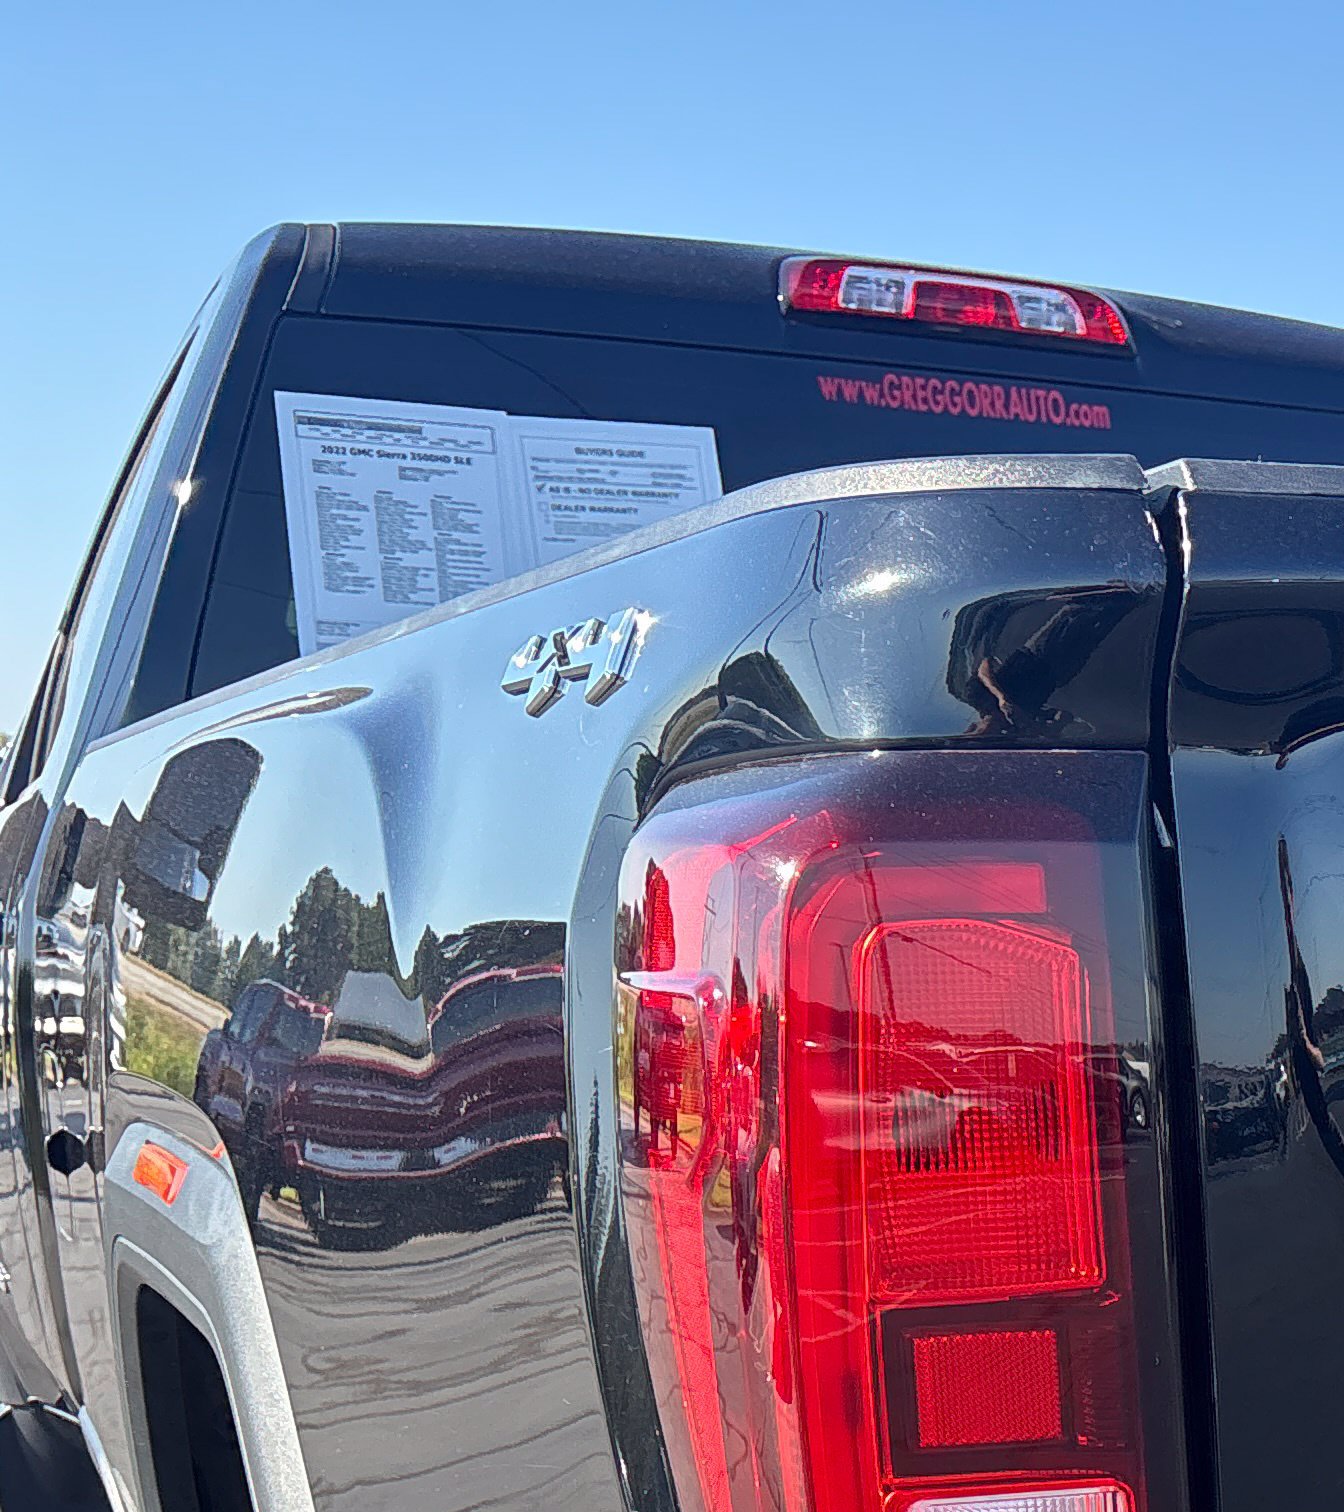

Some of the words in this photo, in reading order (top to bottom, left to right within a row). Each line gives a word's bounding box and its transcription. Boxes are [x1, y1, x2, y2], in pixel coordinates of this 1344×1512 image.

[817, 373, 1112, 430] www.GREGGORRAUTO.com
[320, 445, 347, 456] 2022
[349, 447, 374, 458] GMC
[550, 503, 587, 513] DEALER
[589, 505, 639, 515] WARRANTY
